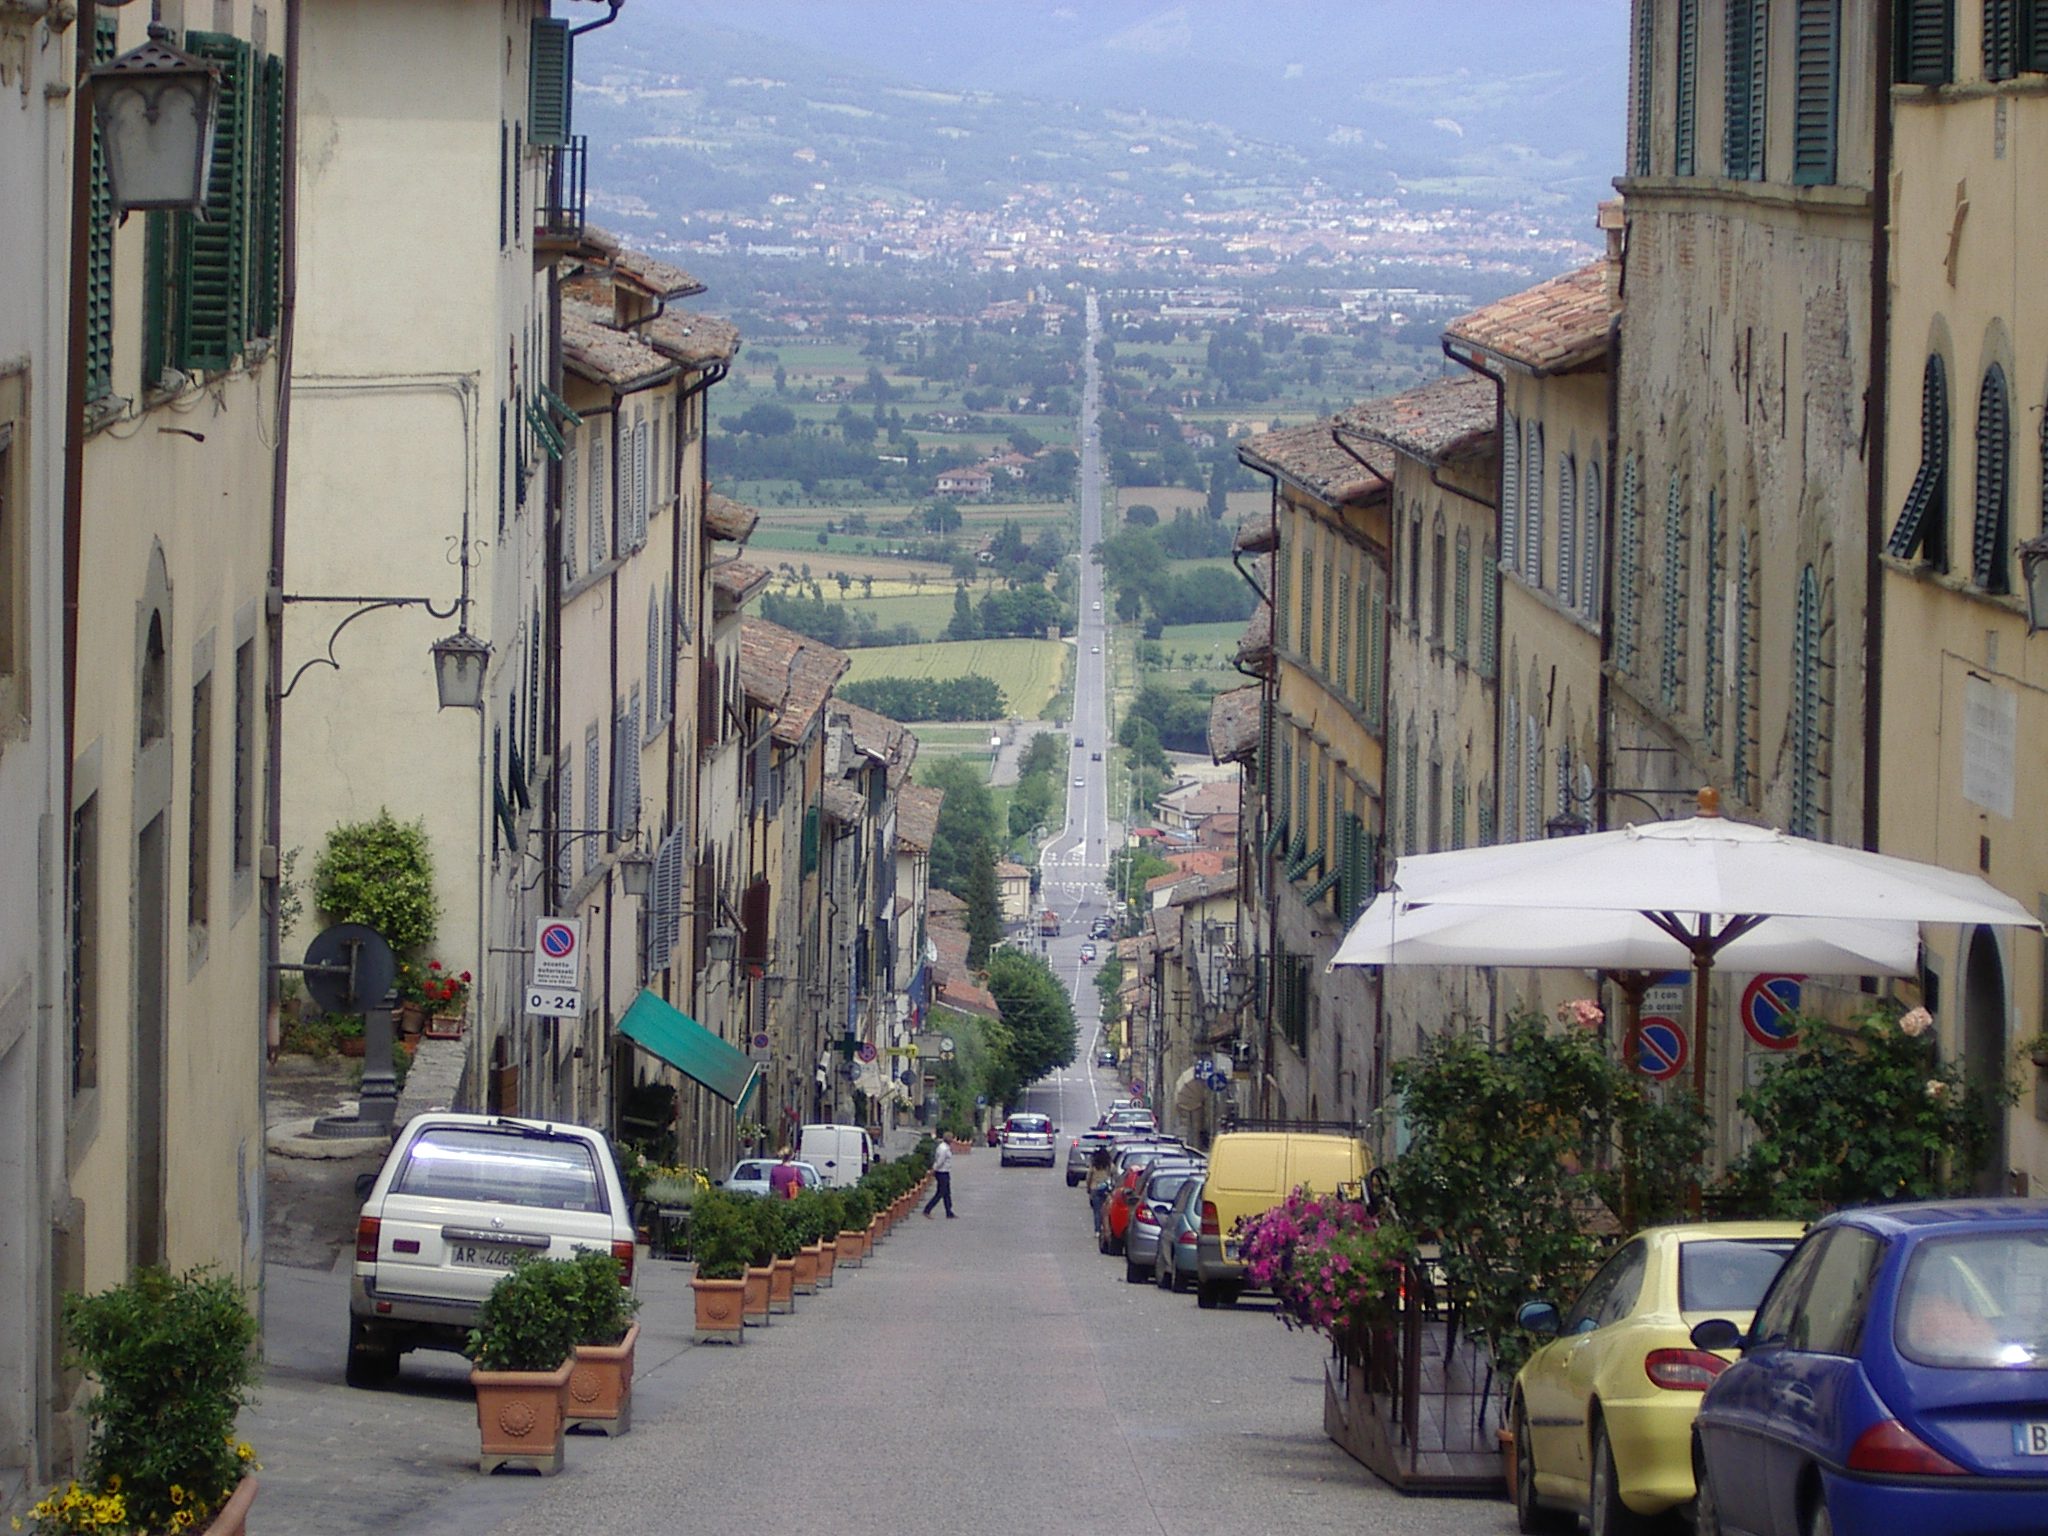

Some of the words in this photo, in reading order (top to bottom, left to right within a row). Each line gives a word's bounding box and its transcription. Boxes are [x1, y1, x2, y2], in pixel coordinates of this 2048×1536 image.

[531, 994, 542, 1007] 0
[554, 996, 576, 1010] 24
[455, 1247, 477, 1263] AR
